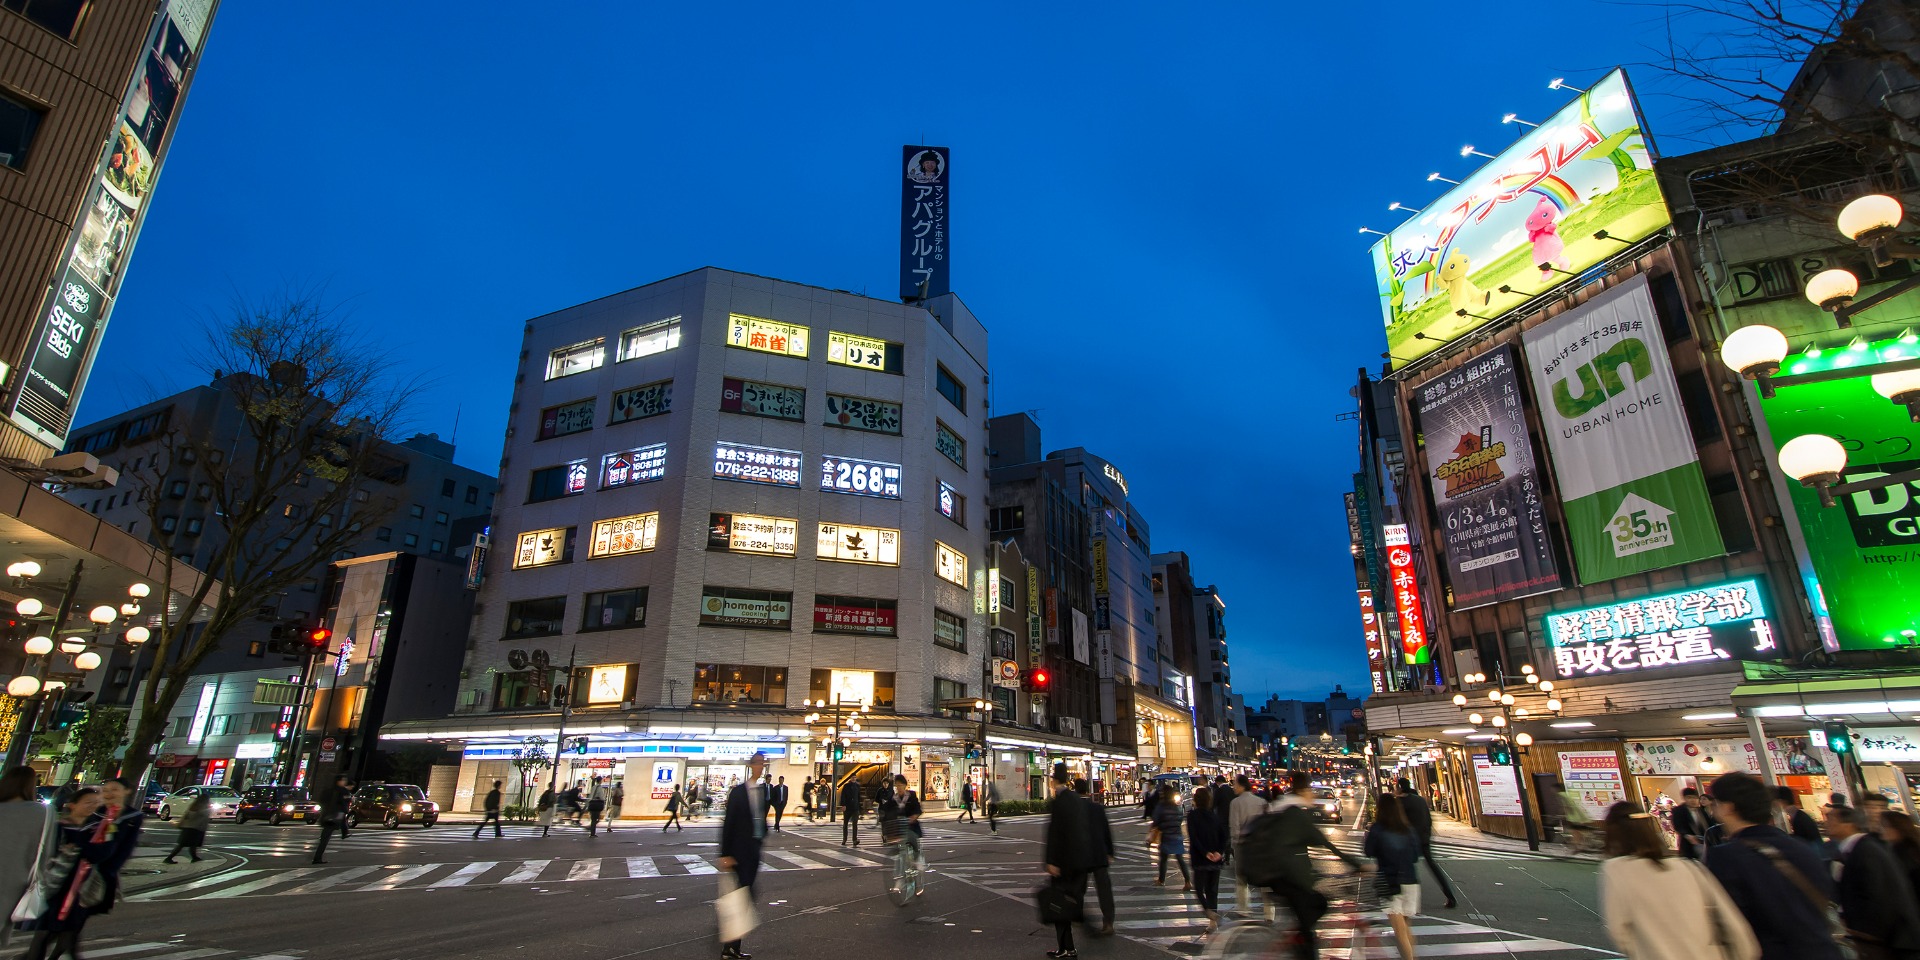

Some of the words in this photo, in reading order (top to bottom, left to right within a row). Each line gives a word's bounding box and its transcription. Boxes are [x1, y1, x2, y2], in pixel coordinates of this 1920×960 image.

[934, 185, 944, 261] マンションとホテルの
[911, 185, 933, 287] アパグループ
[50, 305, 85, 344] SEKI
[48, 328, 72, 359] Bldg
[749, 331, 787, 352] 麻雀
[1543, 320, 1643, 375] おかげさまで35周年
[849, 347, 883, 367] リオ
[723, 389, 741, 400] 6F
[1563, 411, 1611, 439] URBAN
[1616, 392, 1663, 418] HOME
[716, 448, 801, 468] 宴会ご予約承ります
[714, 461, 799, 483] 076-222-1388
[822, 459, 835, 488] 全品
[835, 462, 884, 493] 268
[885, 483, 898, 495] 円
[1457, 462, 1488, 486] 2017
[732, 521, 795, 535] 宴会ご予約承ります
[821, 526, 836, 535] 4F
[1385, 527, 1407, 536] KIRIN
[1449, 516, 1518, 544] 石川県産業展示館
[1613, 509, 1668, 543] 35th
[523, 537, 535, 546] 4F
[733, 540, 794, 551] 076-224-3350
[1618, 533, 1669, 552] anniversary
[1462, 555, 1501, 570] ミリオンロック
[723, 600, 786, 613] homemade
[1394, 571, 1422, 644] 赤玉本店
[1557, 587, 1752, 645] 経営情報学部
[714, 616, 768, 625] ホームメイドクッキング
[1361, 595, 1380, 660] カラオケ
[708, 745, 754, 755] LAWSON
[1655, 756, 1672, 772] 袴
